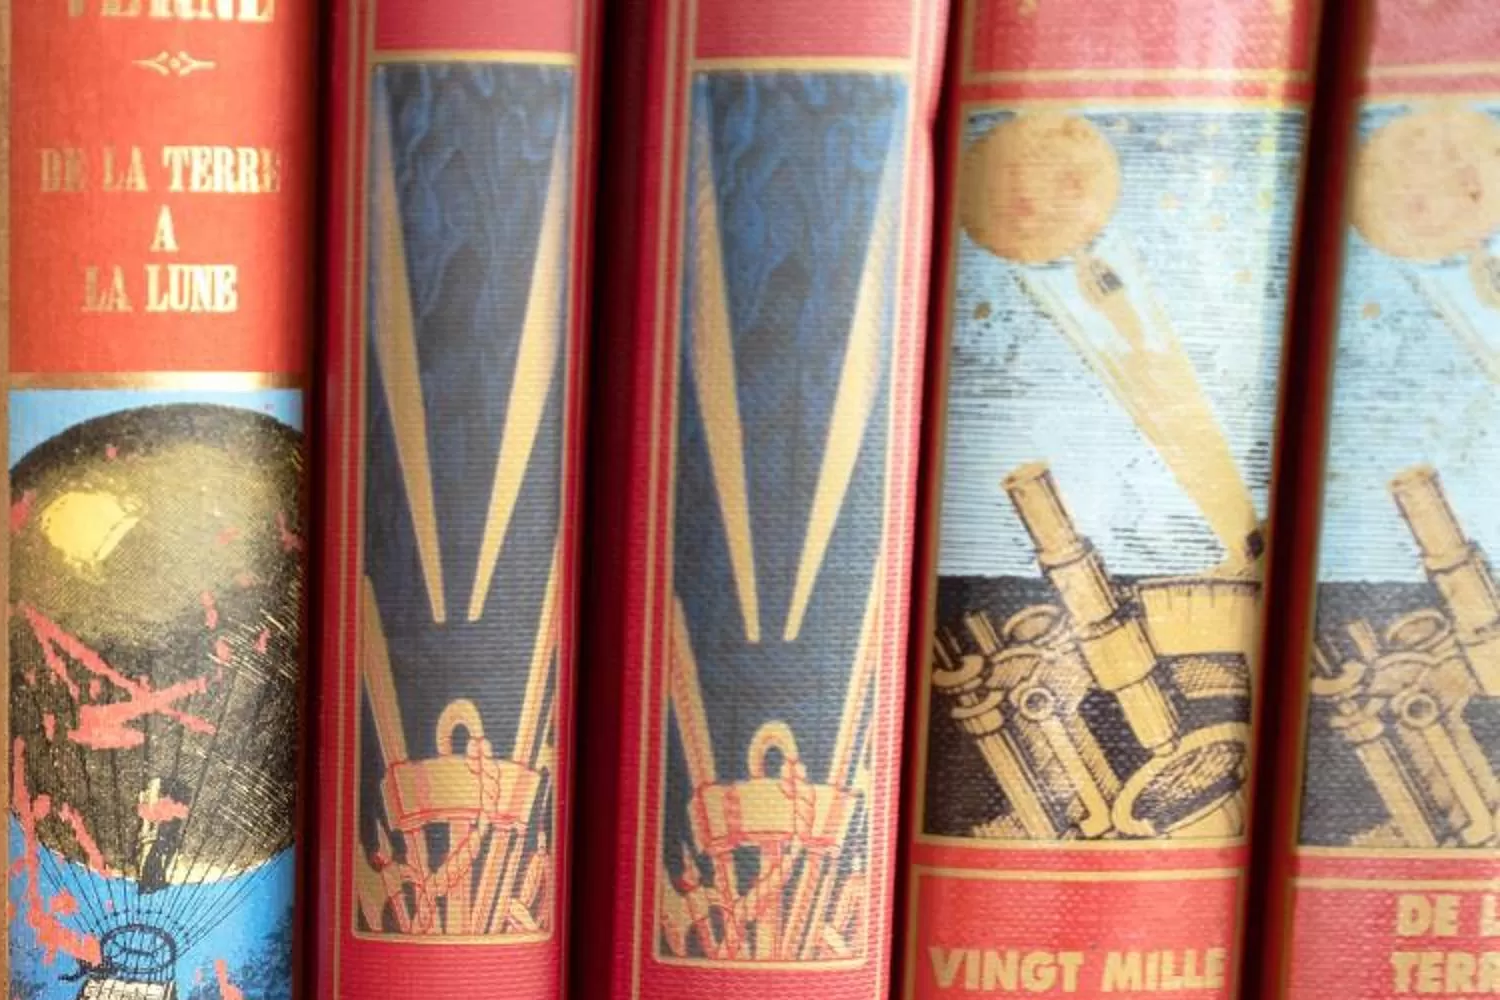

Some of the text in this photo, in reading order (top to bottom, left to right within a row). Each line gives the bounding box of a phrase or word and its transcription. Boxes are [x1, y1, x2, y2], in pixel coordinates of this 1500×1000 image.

[40, 145, 281, 194] DE LA TERRE
[149, 203, 180, 252] A
[80, 263, 239, 313] LA LUNE
[1396, 894, 1462, 937] DE
[929, 947, 1228, 993] VINGT MILLE
